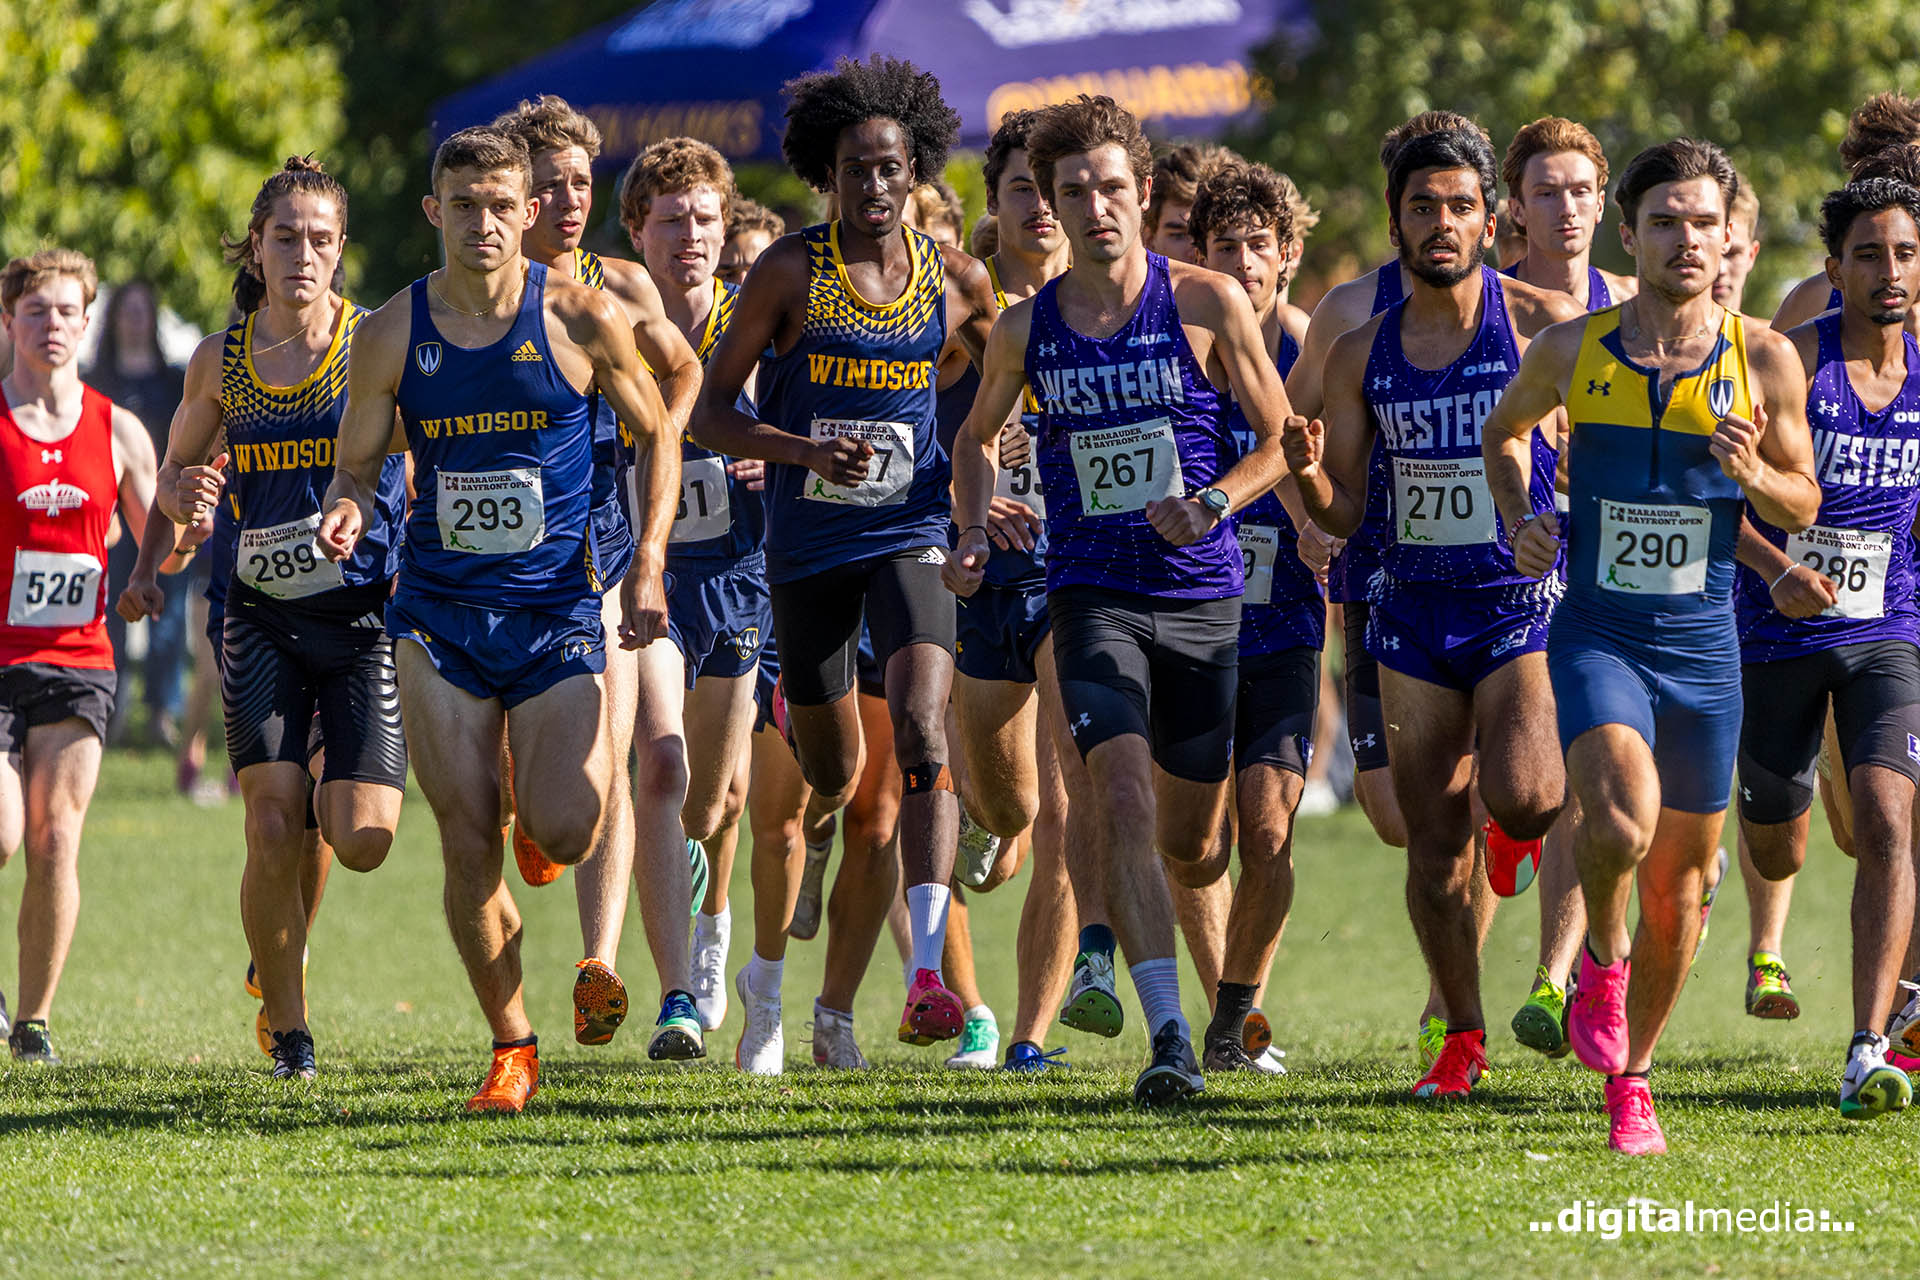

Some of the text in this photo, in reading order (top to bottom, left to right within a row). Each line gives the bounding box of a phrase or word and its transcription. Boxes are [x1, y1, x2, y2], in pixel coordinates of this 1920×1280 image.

[1127, 333, 1172, 347] OUA
[511, 353, 543, 362] adidas
[807, 353, 933, 391] WINDSOR
[1463, 360, 1508, 377] OUA
[1036, 356, 1184, 416] WESTERN
[419, 410, 548, 439] WINDSOR
[1373, 389, 1503, 450] WESTER
[838, 423, 887, 434] MARAUDER
[1091, 427, 1143, 441] MARAUDER
[838, 431, 907, 442] BAYFRONT OPEN
[1092, 429, 1165, 450] BAYFRONT OPEN
[233, 437, 337, 474] WINDSO
[1088, 447, 1154, 490] 267
[1412, 463, 1461, 471] MARAUDER
[1412, 469, 1483, 479] BAYFRONT OPEN
[460, 475, 512, 484] MARAUDER
[460, 480, 534, 492] BAYFRONT OPEN
[1407, 485, 1474, 520] 270
[452, 496, 524, 531] 293
[1627, 508, 1681, 518] MARAUDER
[1626, 516, 1704, 526] BAYFRONT OPEN
[255, 526, 298, 540] MARAUDER
[255, 532, 297, 548] BAYFRONT
[1250, 535, 1273, 545] OPEN
[1817, 530, 1866, 543] MARAUDER
[1615, 531, 1688, 568] 290
[1816, 537, 1885, 552] BAYFRONT OPEN
[249, 543, 317, 583] 289
[1803, 551, 1869, 592] 286
[26, 571, 87, 605] 526
